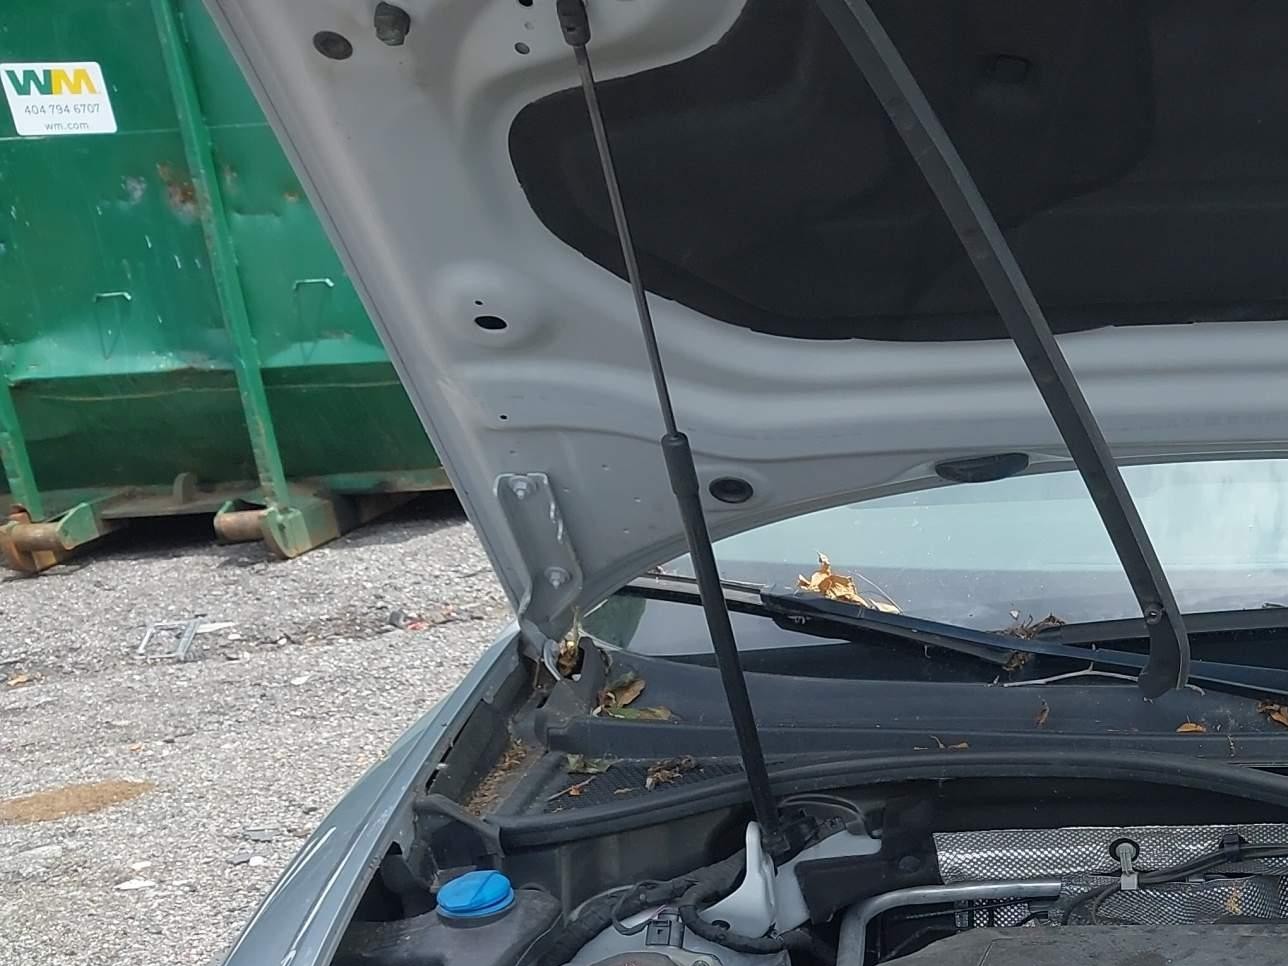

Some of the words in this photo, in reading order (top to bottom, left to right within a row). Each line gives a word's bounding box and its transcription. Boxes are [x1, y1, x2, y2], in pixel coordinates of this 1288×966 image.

[5, 69, 97, 95] WM
[25, 104, 46, 115] 404
[48, 104, 70, 115] 794
[73, 103, 100, 114] 6707
[45, 122, 89, 131] wm.com
